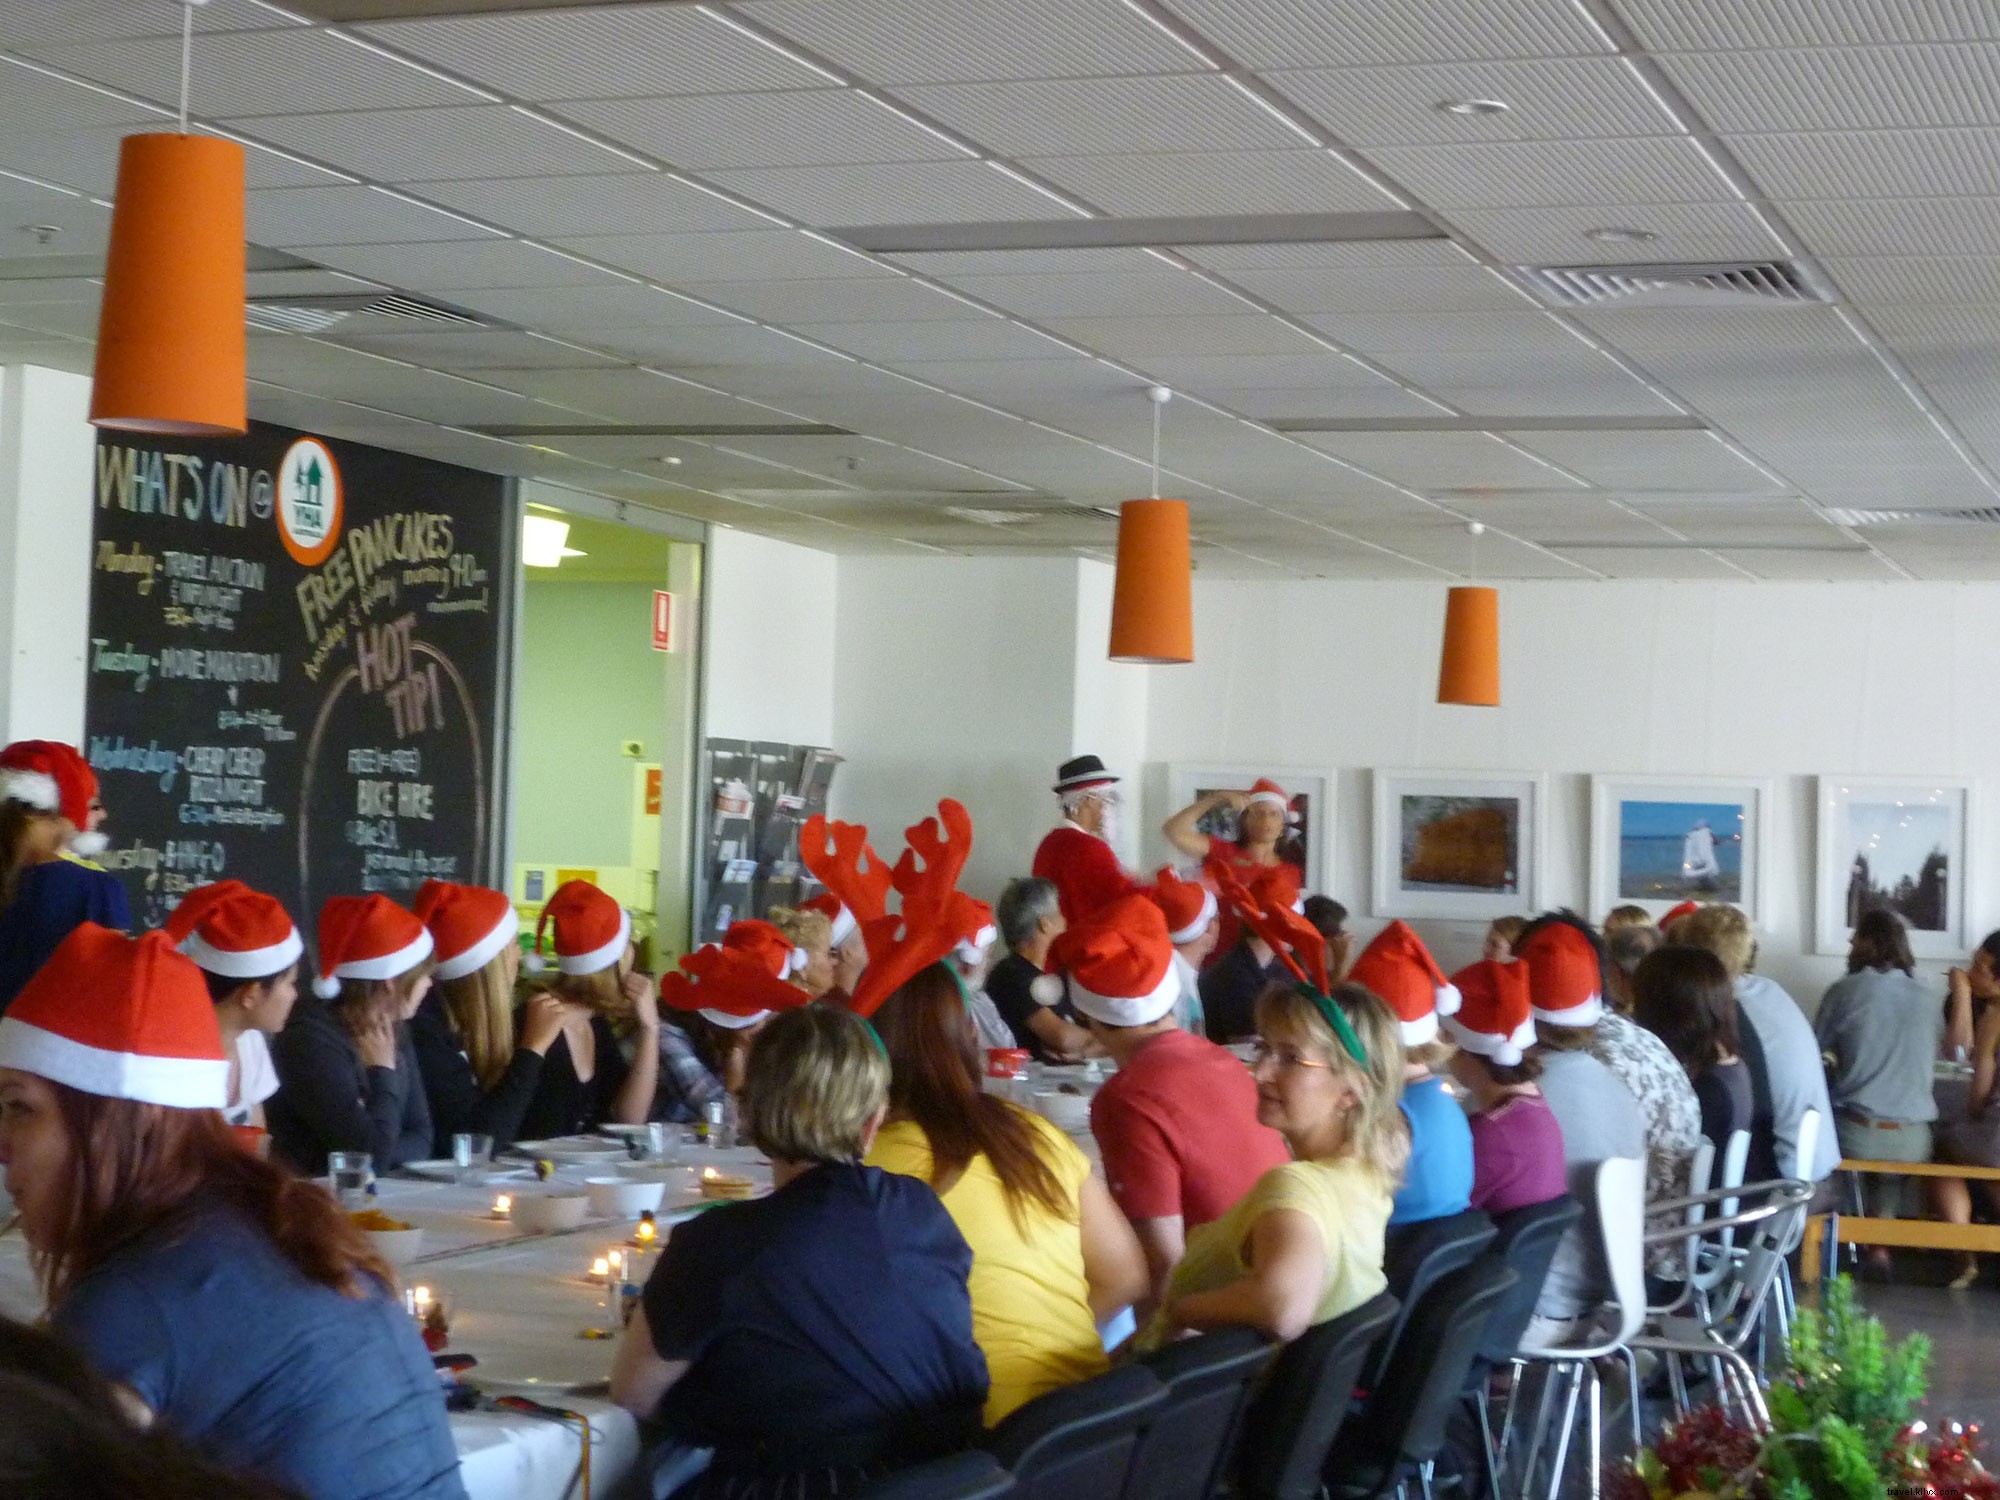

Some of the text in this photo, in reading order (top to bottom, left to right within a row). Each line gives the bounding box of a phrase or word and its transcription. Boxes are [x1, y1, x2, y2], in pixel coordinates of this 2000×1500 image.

[209, 460, 249, 529] ON
[296, 511, 454, 644] FREE PANCAKES
[356, 611, 418, 694] HOT
